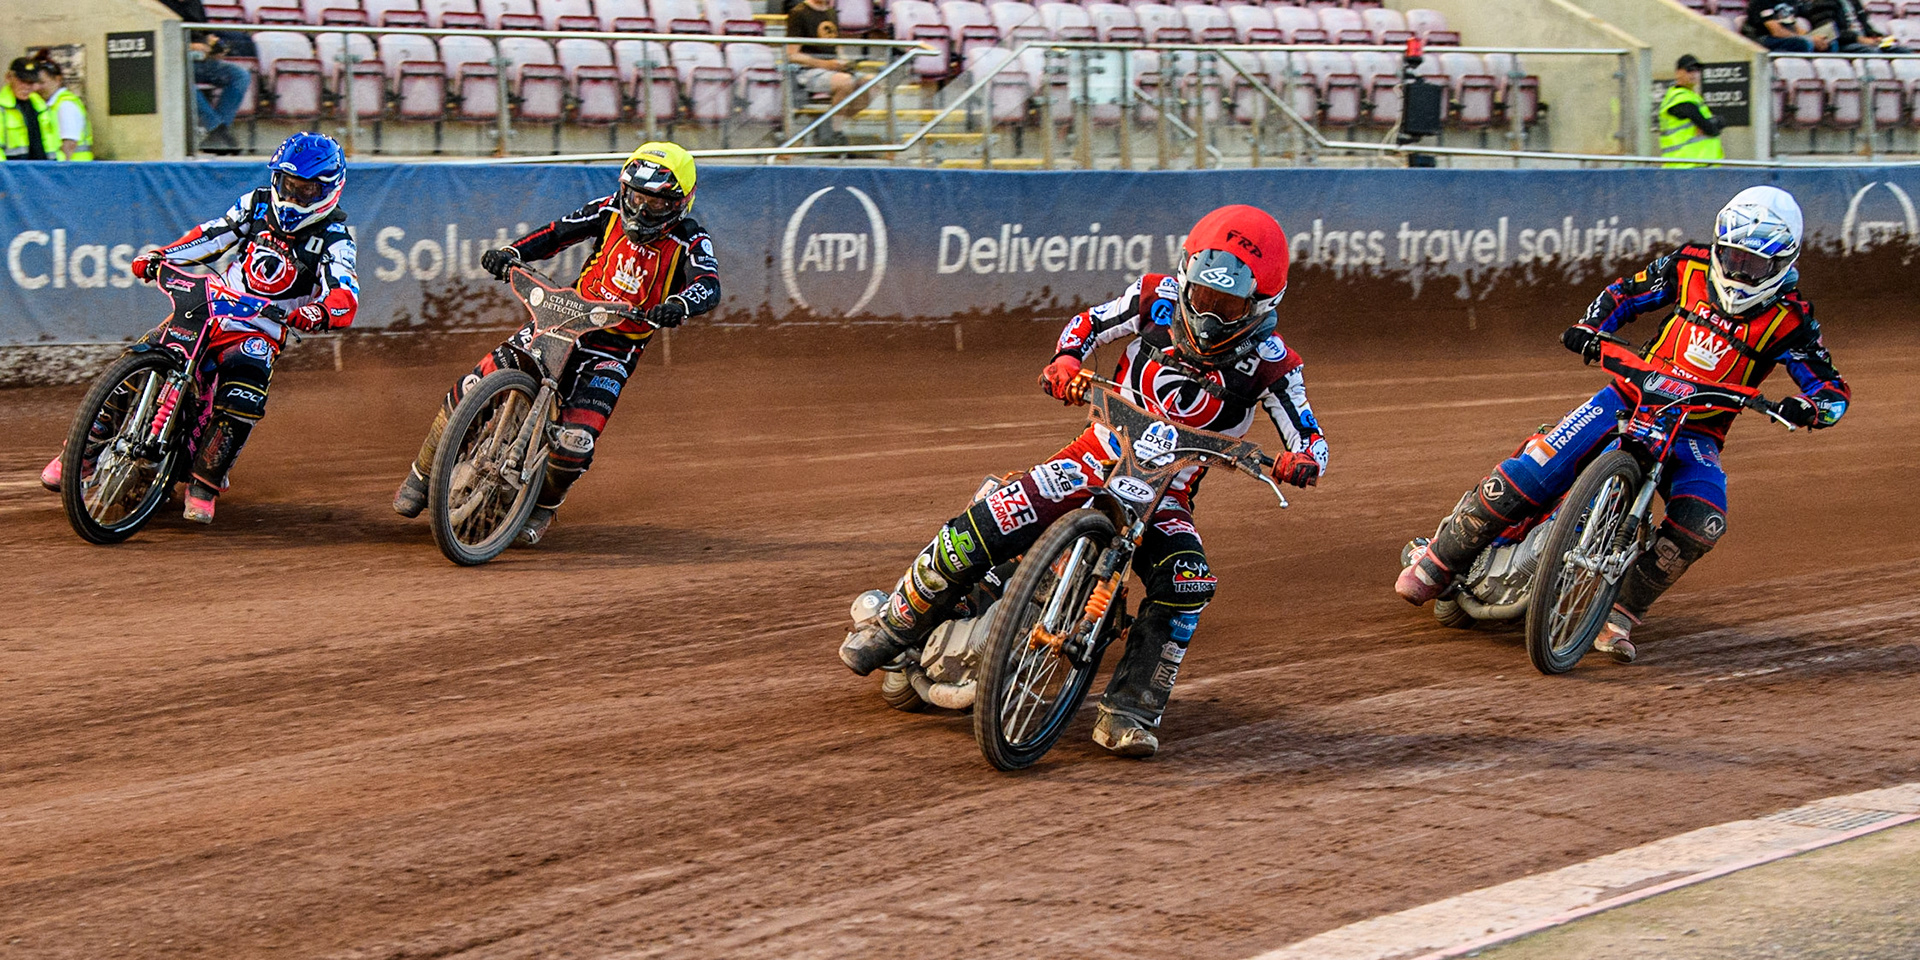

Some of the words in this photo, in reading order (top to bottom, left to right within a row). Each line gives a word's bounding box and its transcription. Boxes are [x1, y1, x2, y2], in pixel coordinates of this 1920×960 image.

[799, 233, 867, 272] ATPI
[937, 222, 1153, 282] Delivering
[1289, 219, 1385, 266] class
[1397, 216, 1508, 264] travel
[1518, 216, 1683, 263] solutions
[542, 300, 586, 320] DETECTION
[549, 294, 564, 305] CTA
[565, 299, 585, 311] FIRE
[1144, 433, 1173, 450] DXB
[1552, 405, 1604, 450] TRAINING
[1051, 463, 1073, 492] DXB
[949, 553, 964, 570] OIL
